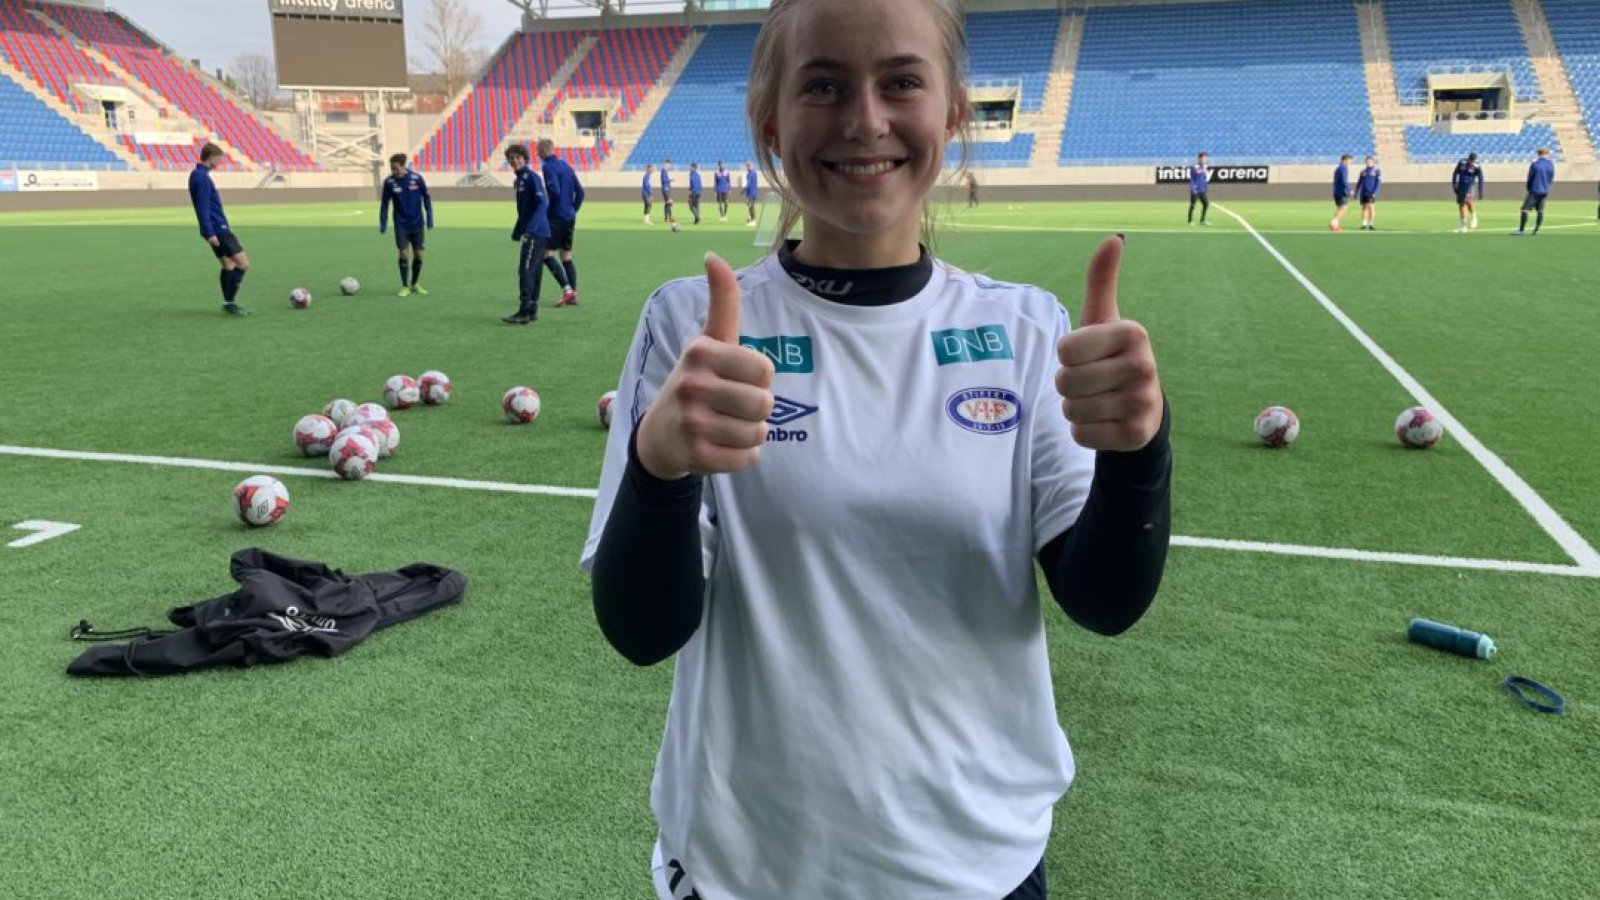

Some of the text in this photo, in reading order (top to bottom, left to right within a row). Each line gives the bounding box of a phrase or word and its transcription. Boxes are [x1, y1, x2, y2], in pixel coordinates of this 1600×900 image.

[345, 0, 395, 10] arena
[1158, 166, 1268, 182] intily arena
[742, 335, 805, 366] NB
[943, 328, 1005, 364] DNB
[766, 427, 808, 442] mbro
